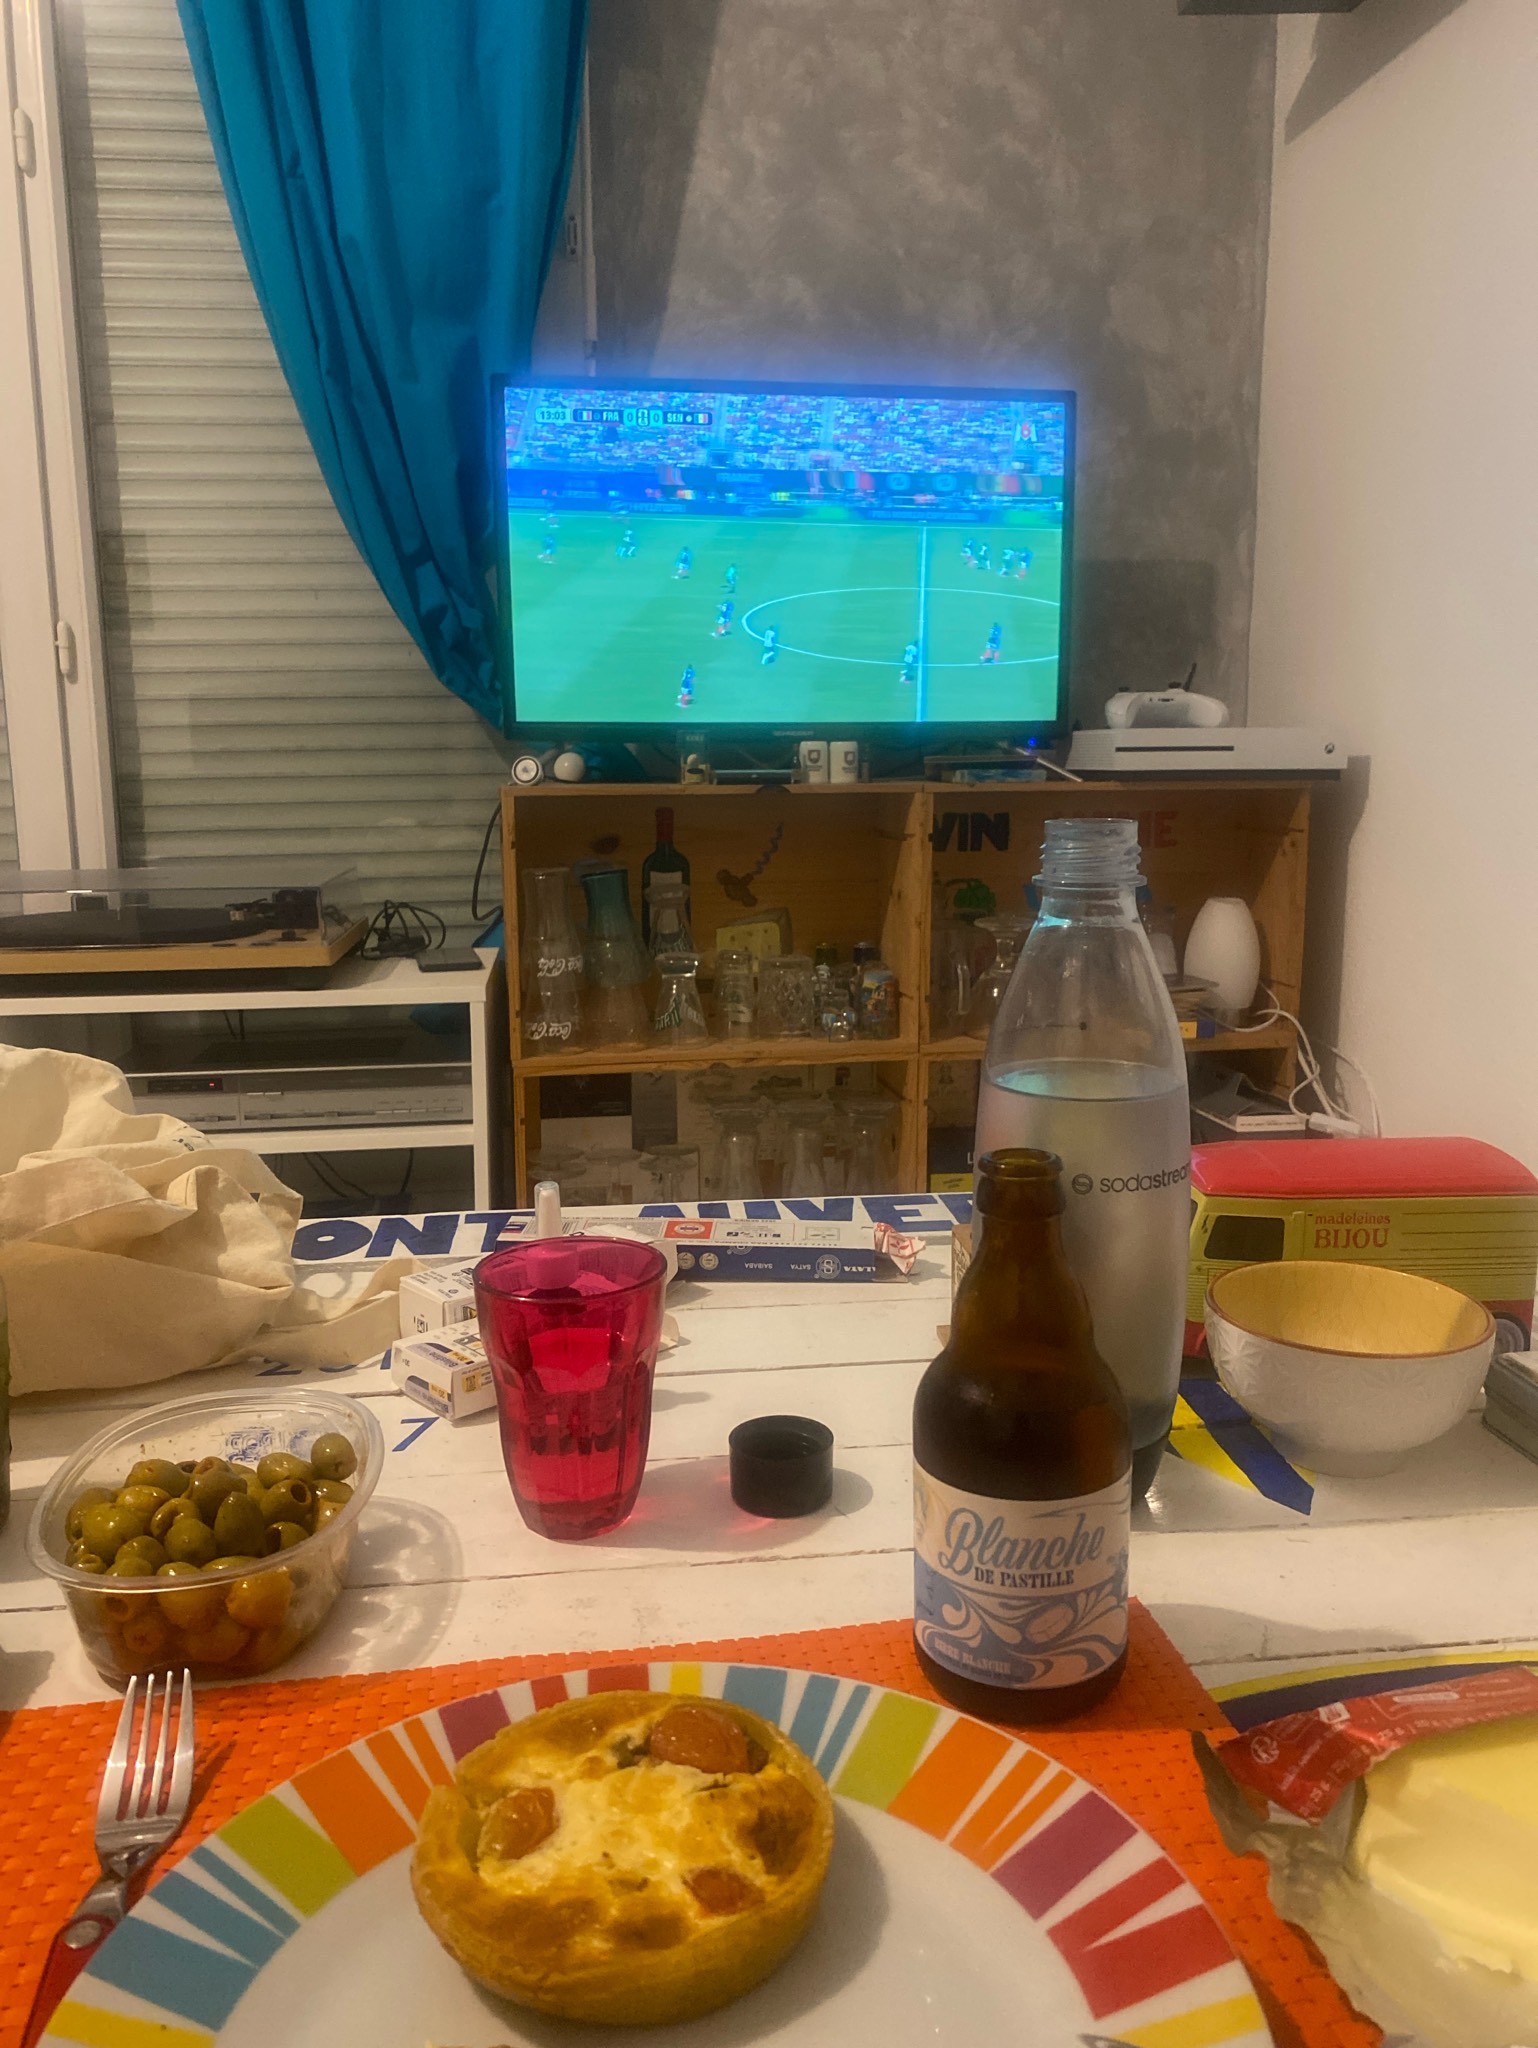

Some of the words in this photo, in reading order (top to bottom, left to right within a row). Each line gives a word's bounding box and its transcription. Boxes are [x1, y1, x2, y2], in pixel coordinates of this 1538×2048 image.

[539, 410, 567, 421] 13:03
[602, 411, 619, 422] FRA
[667, 412, 684, 423] SEN
[1315, 1212, 1390, 1225] madeleines
[1314, 1228, 1389, 1249] BIJOU
[790, 1263, 812, 1271] SATYA
[938, 1507, 1106, 1576] Blanche
[974, 1566, 995, 1584] DE
[1000, 1569, 1076, 1589] PASTILLE
